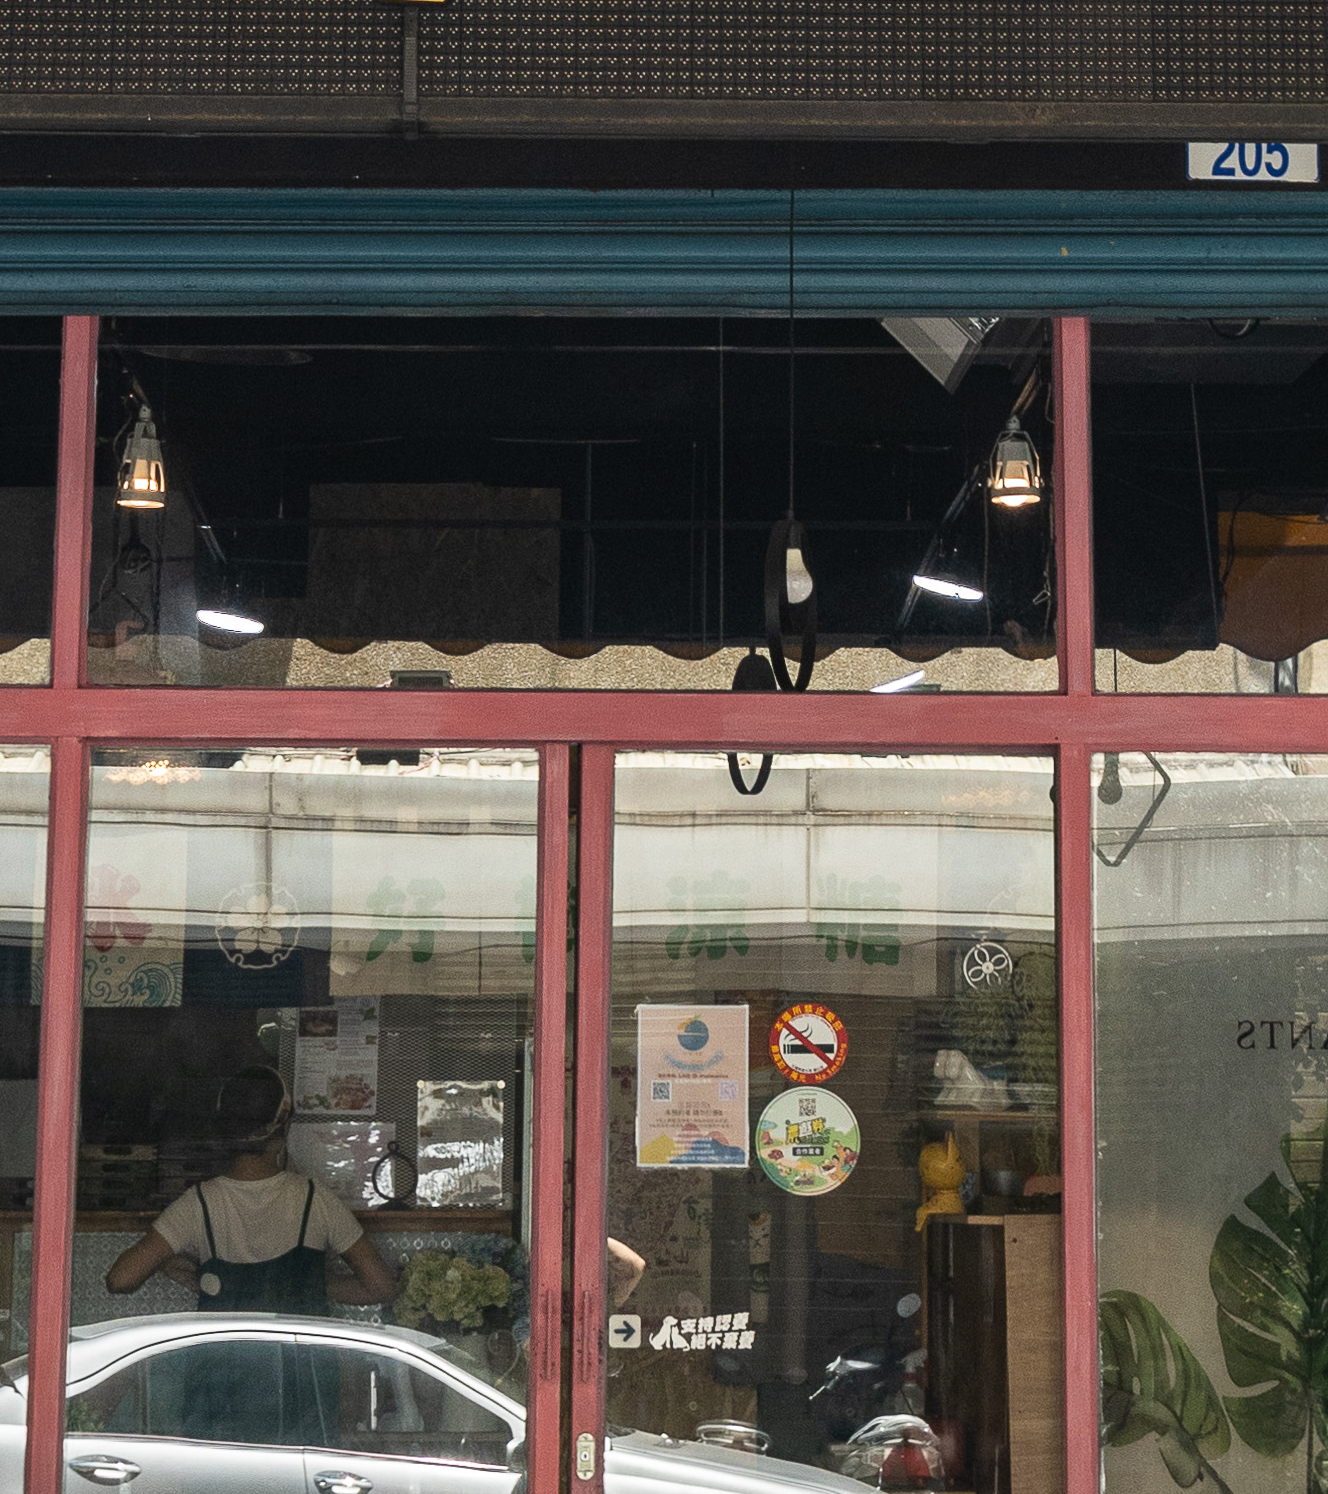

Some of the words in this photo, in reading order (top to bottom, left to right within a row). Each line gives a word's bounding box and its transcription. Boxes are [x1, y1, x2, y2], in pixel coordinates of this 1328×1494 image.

[1211, 142, 1289, 177] 205
[681, 1312, 749, 1334] 支持認養
